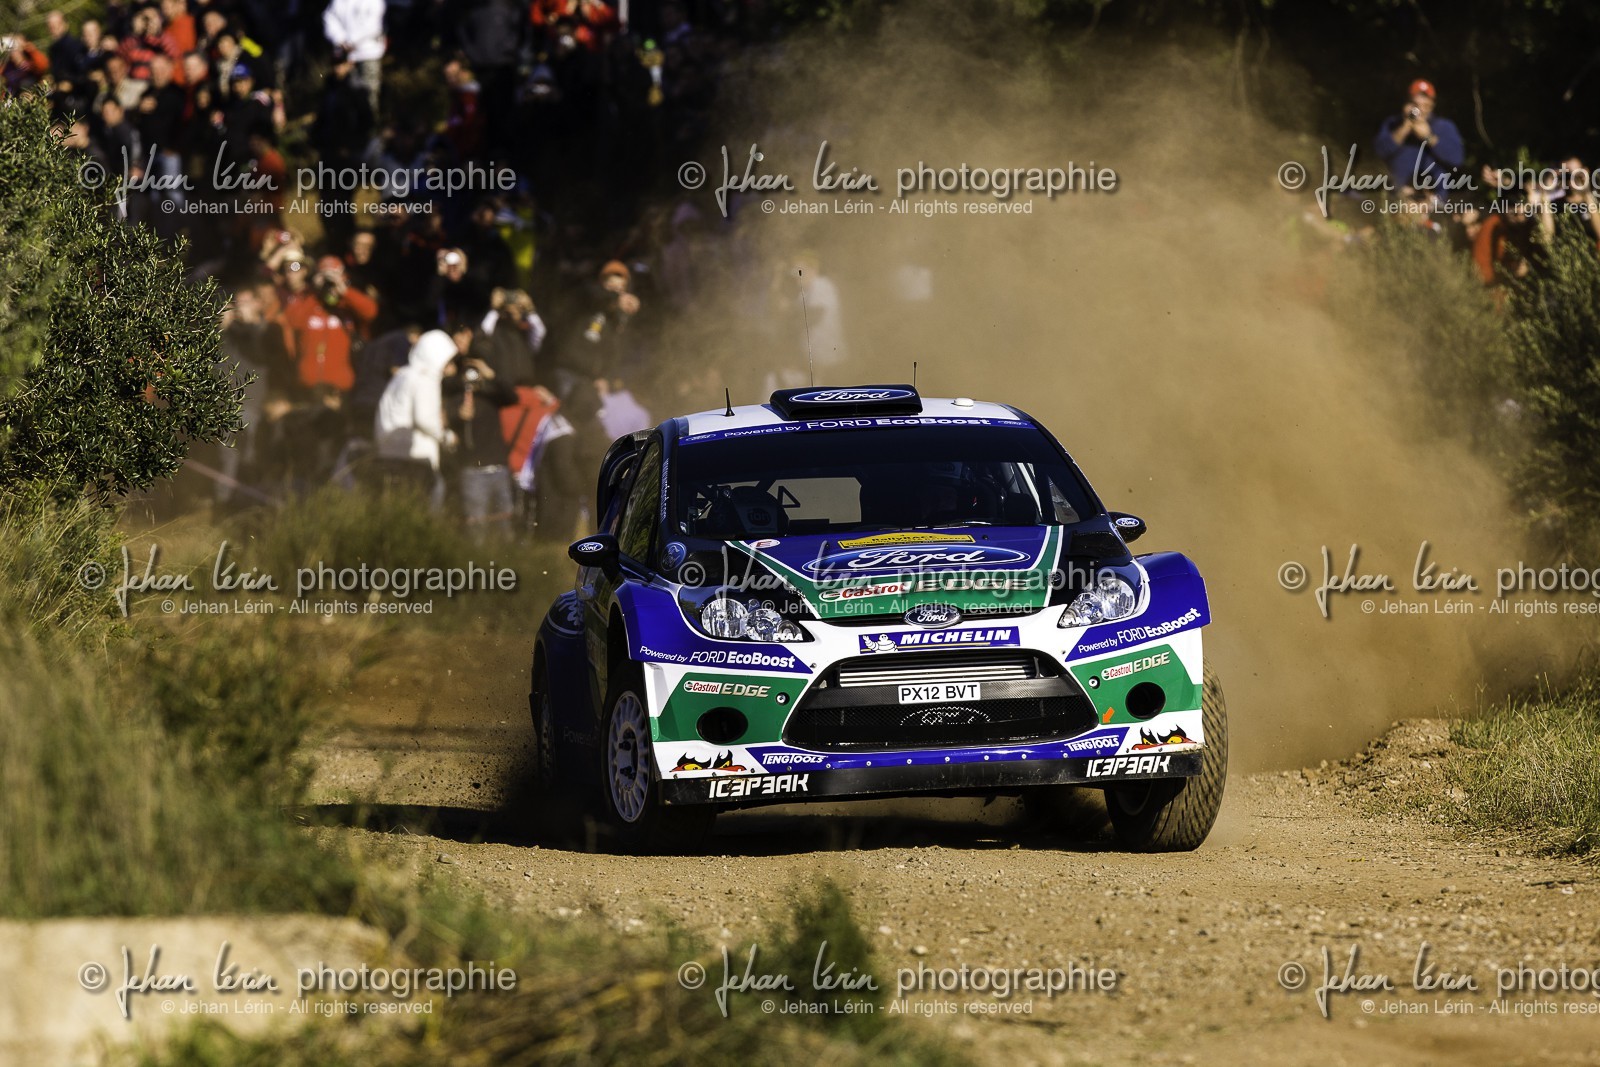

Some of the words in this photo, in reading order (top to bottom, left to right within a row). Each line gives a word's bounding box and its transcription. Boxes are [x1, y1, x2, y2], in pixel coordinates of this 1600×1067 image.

[813, 388, 890, 402] Ford
[724, 427, 782, 437] Powered
[785, 425, 801, 433] by
[807, 419, 872, 429] FORD
[876, 418, 991, 426] EcoBoost
[848, 548, 985, 568] Ford
[842, 582, 906, 599] Castrol
[914, 578, 1031, 592] EDGE
[917, 609, 948, 622] Ford
[900, 629, 1012, 645] MICHELIN
[1078, 640, 1109, 654] Powered
[1108, 637, 1118, 647] by
[1117, 626, 1147, 644] FORD
[1145, 607, 1202, 638] EcoBoost
[640, 645, 678, 661] Powered
[676, 653, 688, 663] by
[689, 651, 727, 663] FORD
[727, 651, 796, 669] EcoBoost
[1109, 664, 1132, 678] Castrol
[1133, 651, 1171, 673] EDGE
[692, 682, 720, 693] Castrol
[721, 683, 771, 698] EDGE
[901, 686, 940, 702] PX12
[945, 684, 978, 700] BVT
